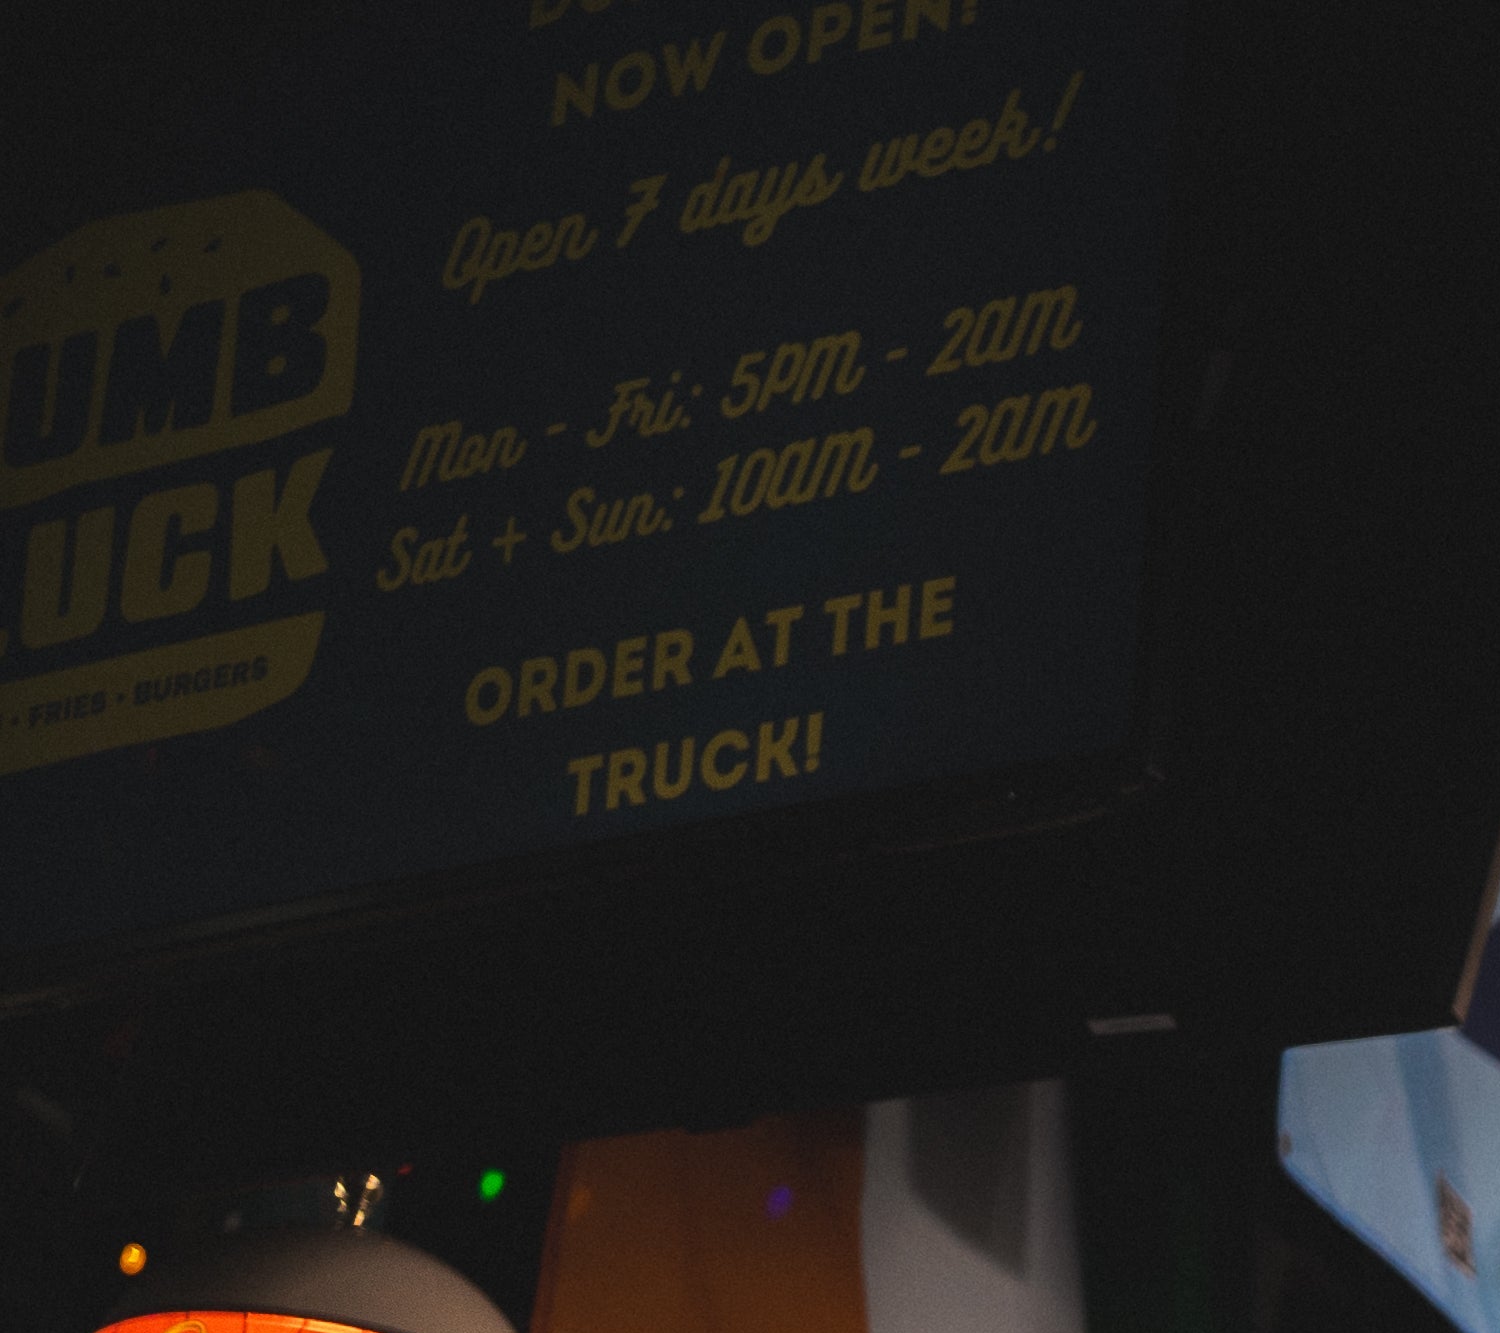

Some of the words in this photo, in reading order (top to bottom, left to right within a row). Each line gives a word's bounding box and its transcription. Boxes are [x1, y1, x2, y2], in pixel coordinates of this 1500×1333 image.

[552, 32, 725, 127] NOW
[442, 213, 598, 304] Open
[616, 173, 666, 248] 7
[679, 155, 843, 247] days
[857, 72, 1083, 193] week!
[399, 420, 527, 491] Mon
[0, 448, 332, 660] UCK
[375, 515, 472, 592] Sat
[133, 655, 270, 706] BURGERS
[464, 628, 695, 727] ORDER
[712, 605, 805, 679] AT
[823, 575, 957, 657] THE
[566, 710, 826, 816] TRUCK!
